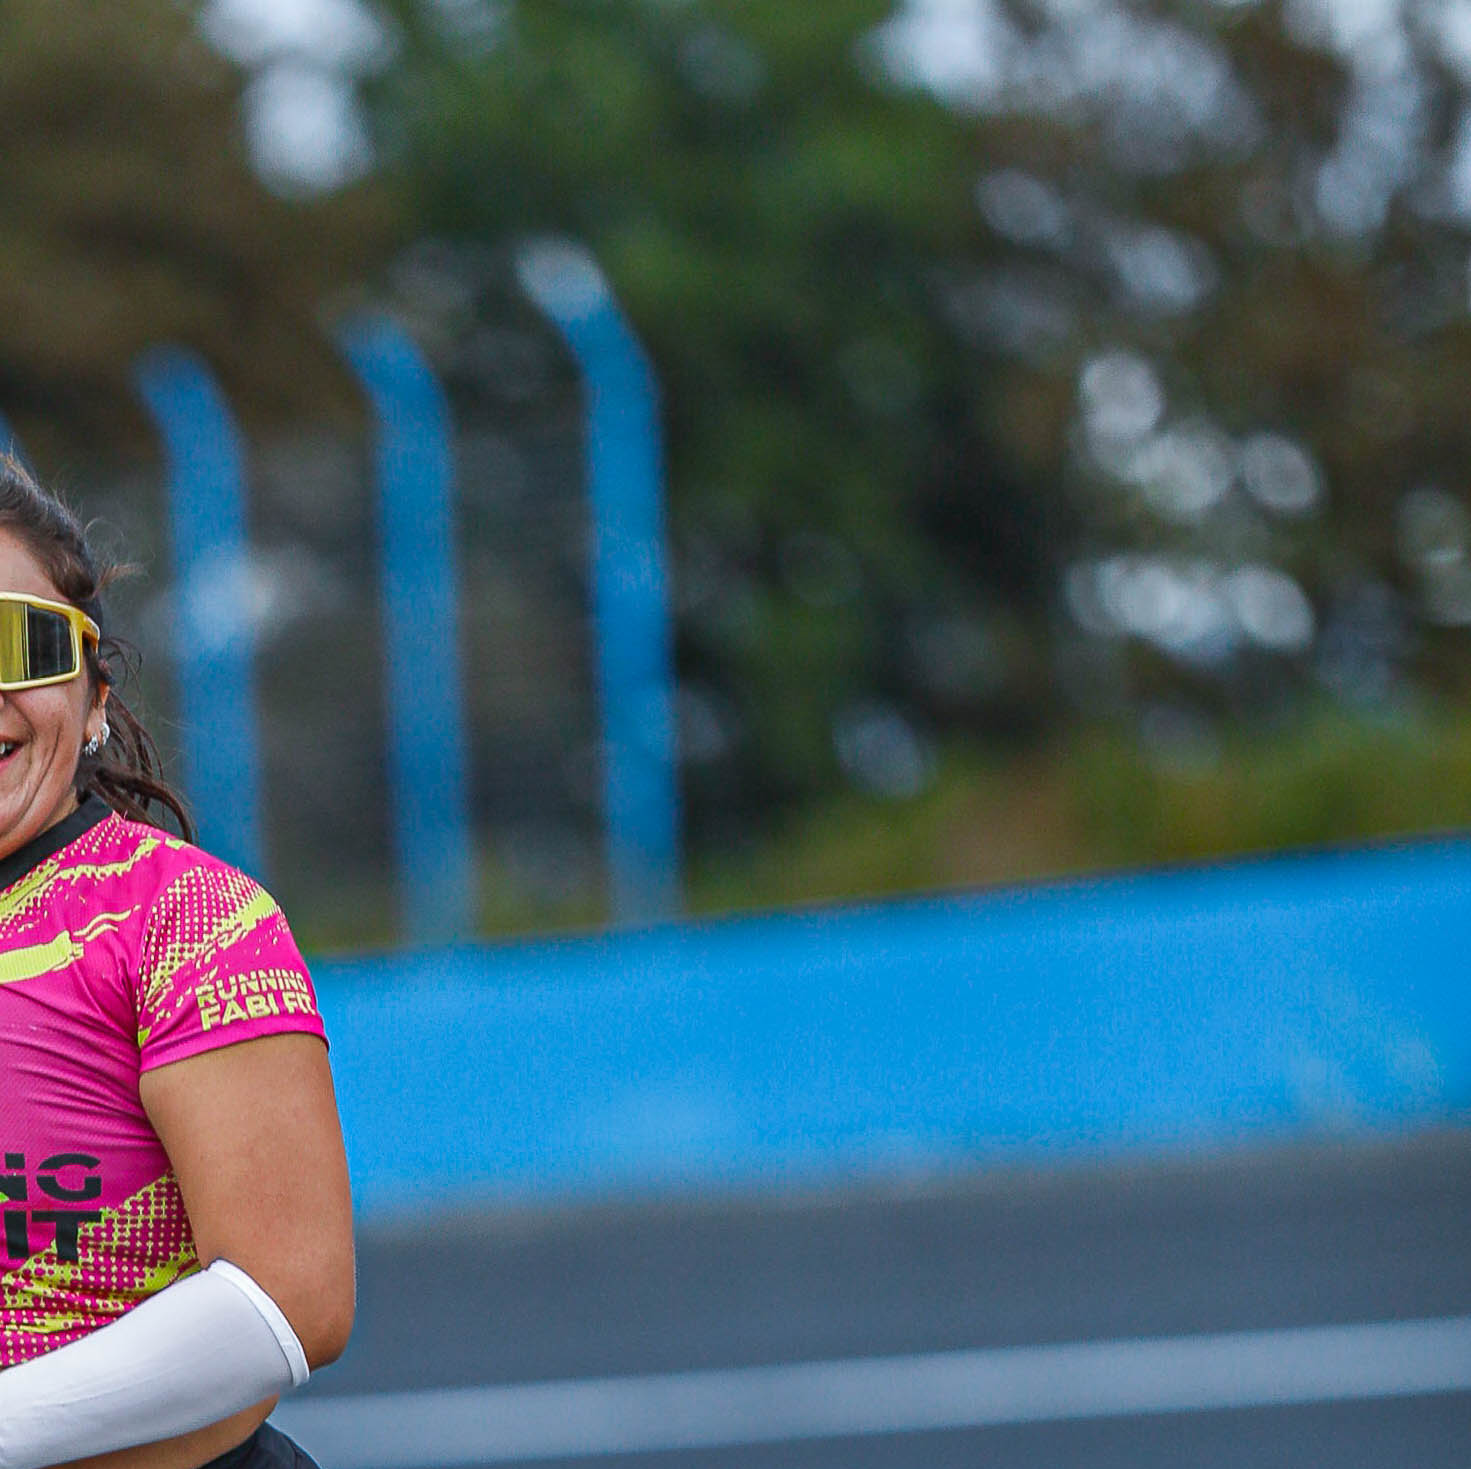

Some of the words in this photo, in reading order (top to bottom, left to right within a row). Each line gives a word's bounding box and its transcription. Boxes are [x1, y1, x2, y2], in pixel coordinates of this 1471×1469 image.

[195, 968, 308, 1009] RUNNING
[200, 992, 280, 1032] FABI
[282, 991, 316, 1016] FIT
